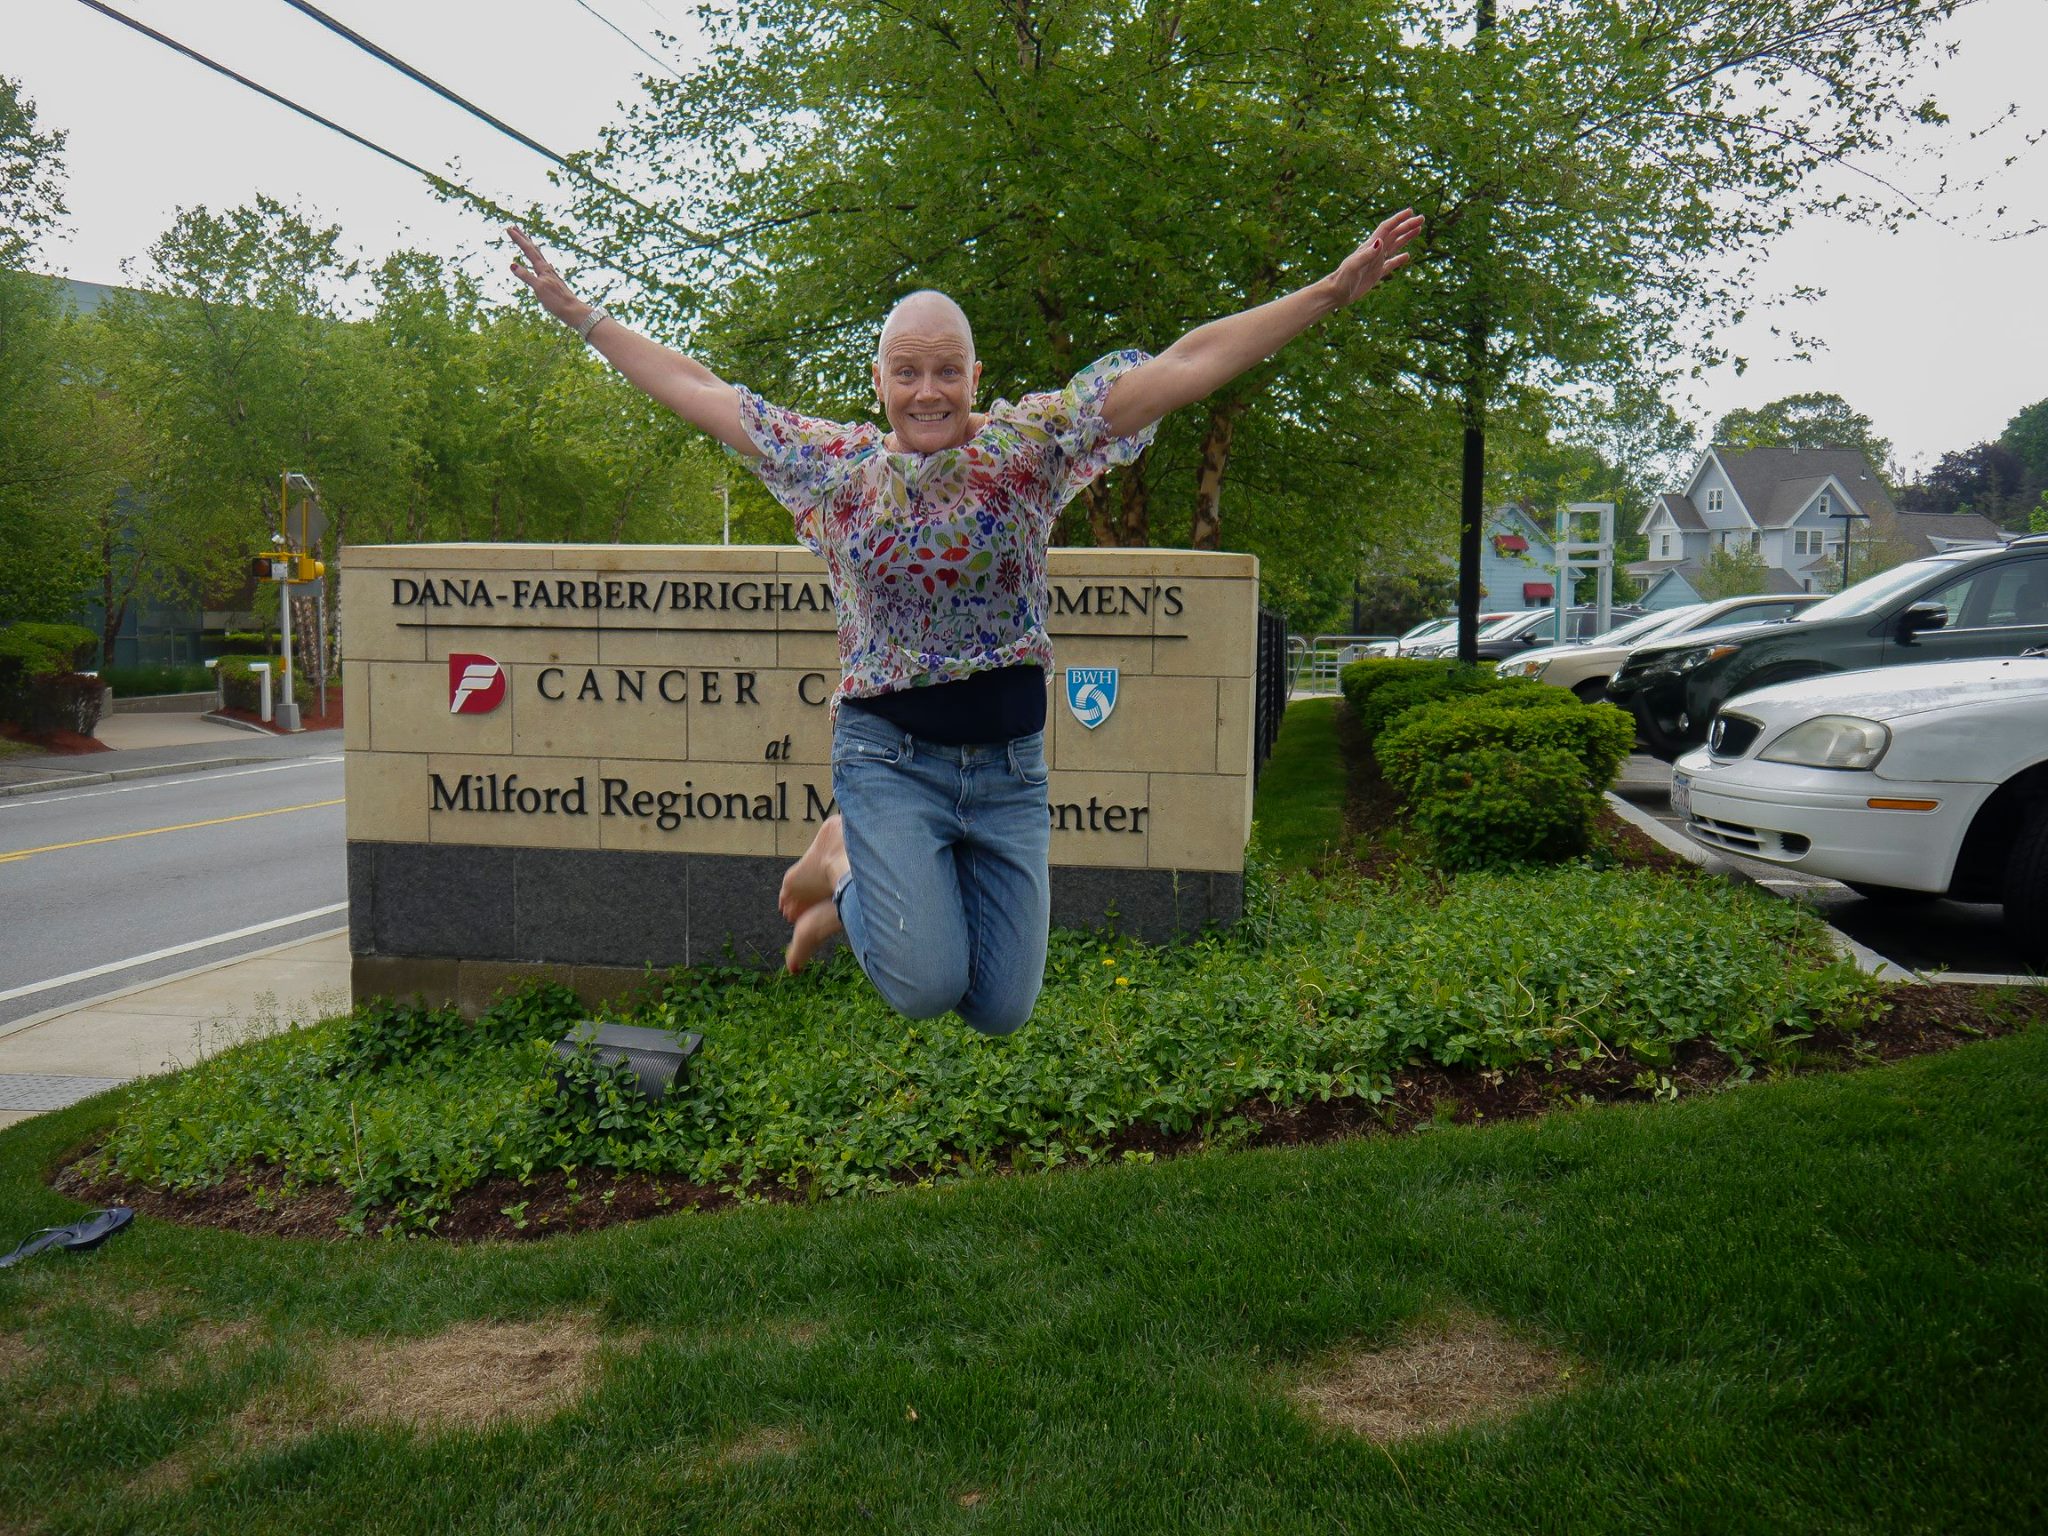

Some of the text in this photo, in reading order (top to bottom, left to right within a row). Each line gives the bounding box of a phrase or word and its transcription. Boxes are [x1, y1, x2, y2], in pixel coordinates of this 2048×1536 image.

[1047, 585, 1184, 616] MEN'S
[536, 667, 760, 705] CANCER
[1071, 670, 1113, 685] BWH
[764, 734, 791, 761] at
[429, 772, 588, 816] Milford
[600, 777, 789, 832] Regional
[1047, 796, 1150, 833] nter
